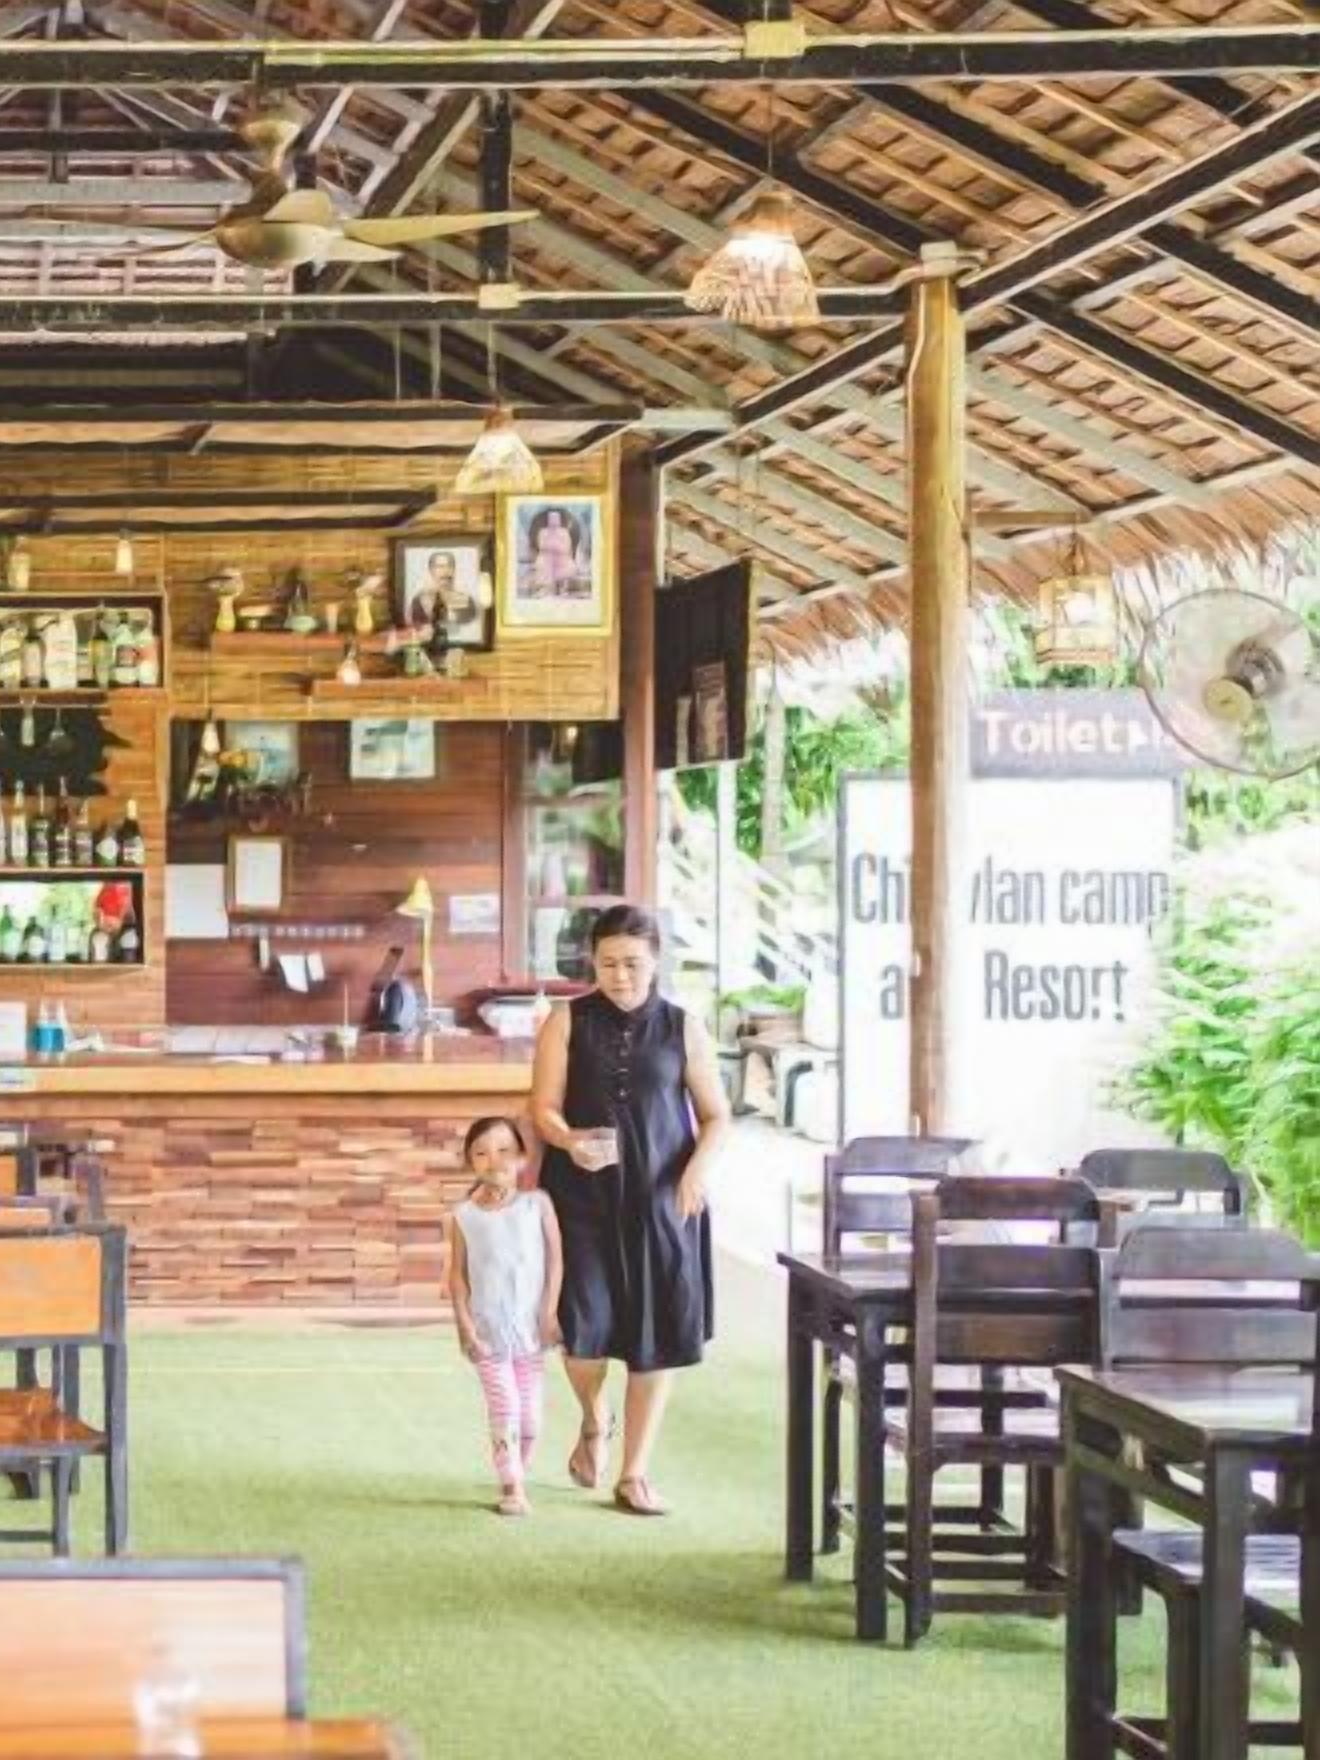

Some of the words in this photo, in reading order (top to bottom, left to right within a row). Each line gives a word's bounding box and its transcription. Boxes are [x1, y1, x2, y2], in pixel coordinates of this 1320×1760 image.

[978, 711, 1123, 755] Toilet
[1059, 869, 1170, 938] camp
[983, 949, 1130, 1023] Resort
